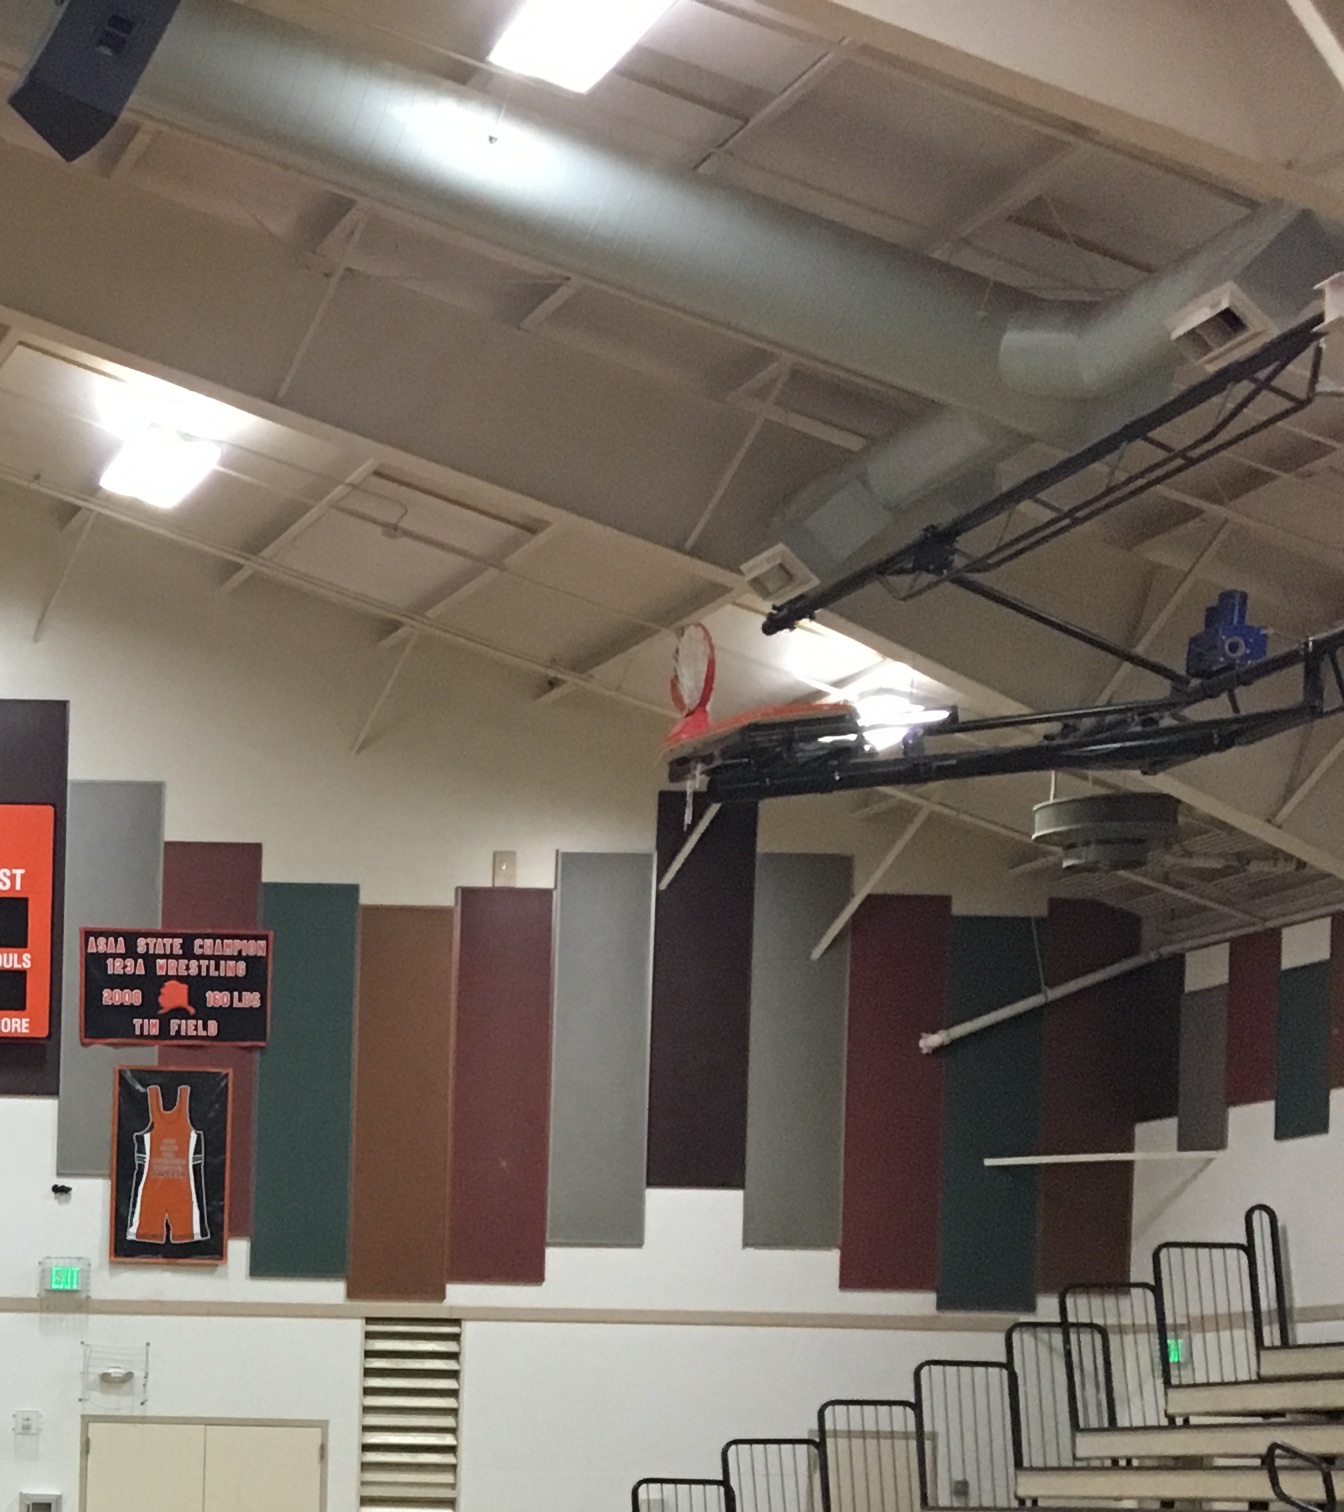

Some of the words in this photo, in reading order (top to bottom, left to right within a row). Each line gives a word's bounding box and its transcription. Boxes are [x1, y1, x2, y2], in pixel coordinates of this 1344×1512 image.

[87, 936, 125, 953] ASAA
[137, 938, 183, 954] STATE
[194, 938, 267, 956] CHAMPION
[156, 959, 246, 977] WRESTLING
[232, 991, 260, 1007] LBS
[133, 1018, 159, 1035] TIM
[170, 1019, 218, 1036] FIELD
[51, 1266, 80, 1289] EXIT
